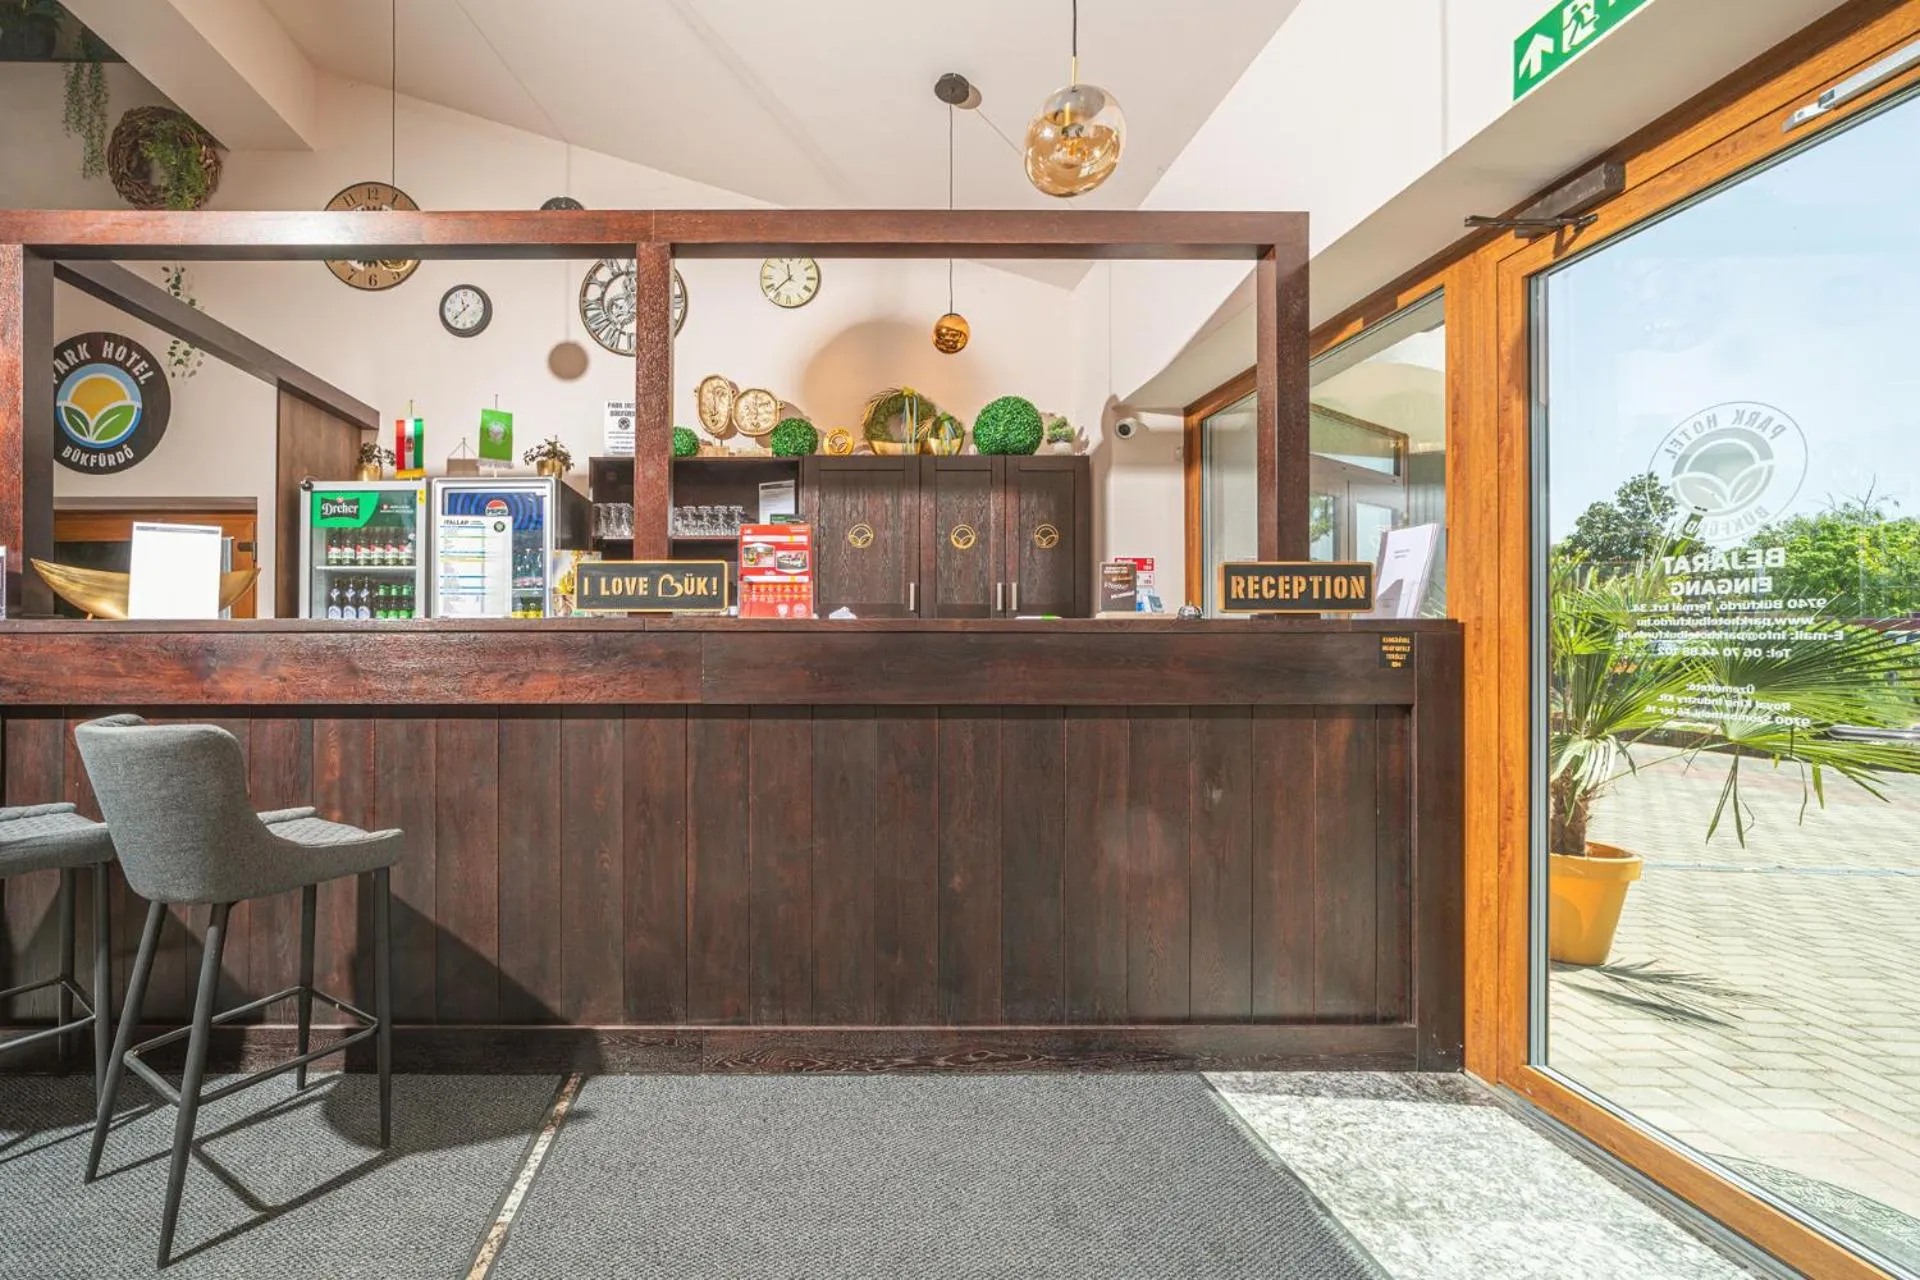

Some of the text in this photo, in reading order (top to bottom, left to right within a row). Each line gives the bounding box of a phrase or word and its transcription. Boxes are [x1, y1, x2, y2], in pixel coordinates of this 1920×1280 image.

[367, 187, 379, 200] 12
[347, 269, 358, 281] 7
[369, 274, 378, 287] 6
[102, 341, 155, 385] HOTEL
[62, 444, 135, 467] BÜKFÜRDŐ
[321, 502, 360, 516] Dreher
[583, 576, 590, 596] I
[600, 576, 649, 596] LOVE
[1230, 574, 1367, 600] RECEPTION
